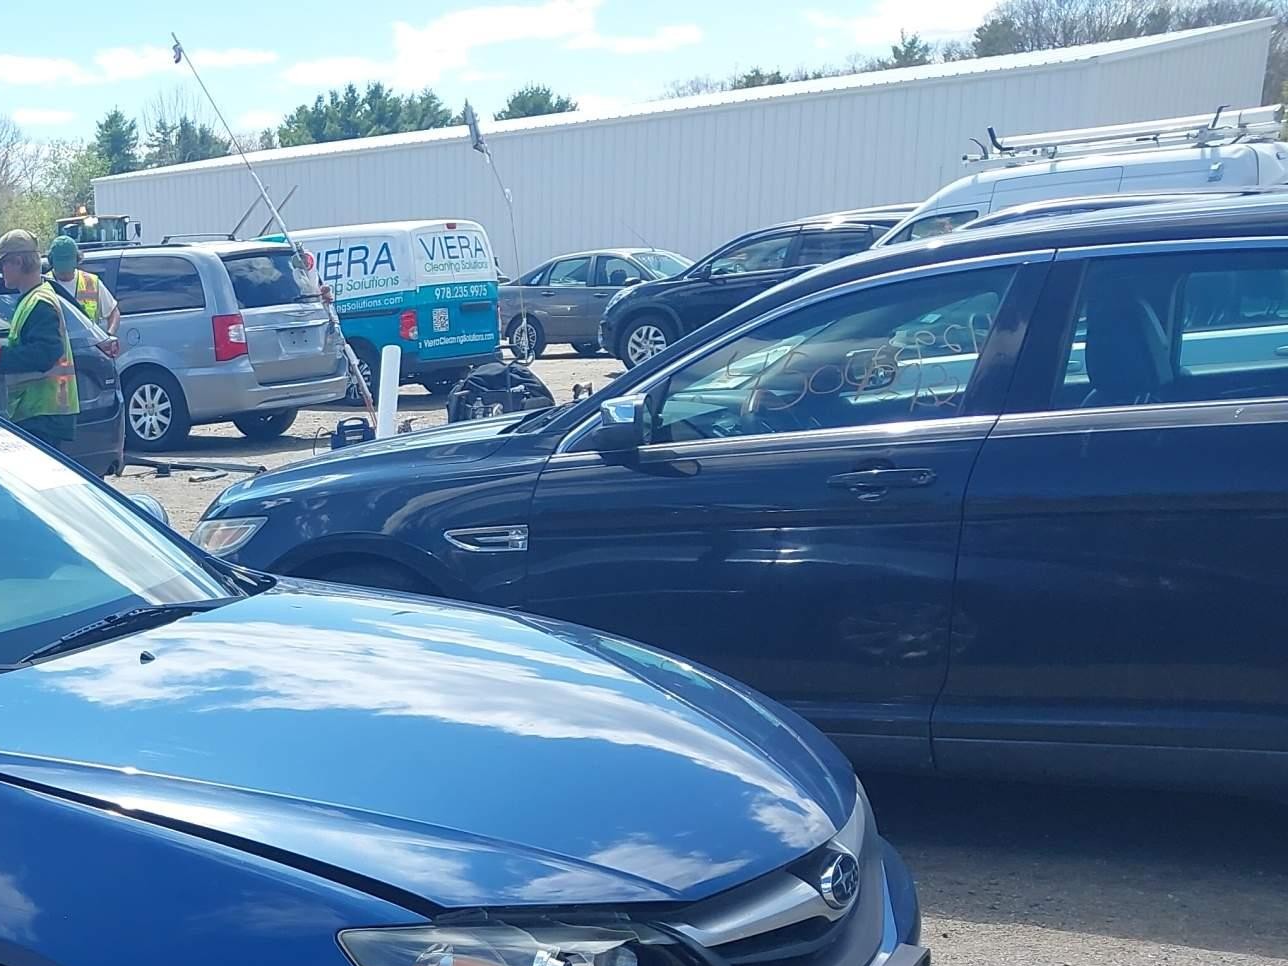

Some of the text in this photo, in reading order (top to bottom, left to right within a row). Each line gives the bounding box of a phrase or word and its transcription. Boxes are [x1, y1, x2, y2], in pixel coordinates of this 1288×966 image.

[419, 235, 487, 260] VIERA
[316, 242, 396, 282] IERA
[424, 260, 489, 272] Cleaning Solutions
[346, 275, 400, 292] Solutions
